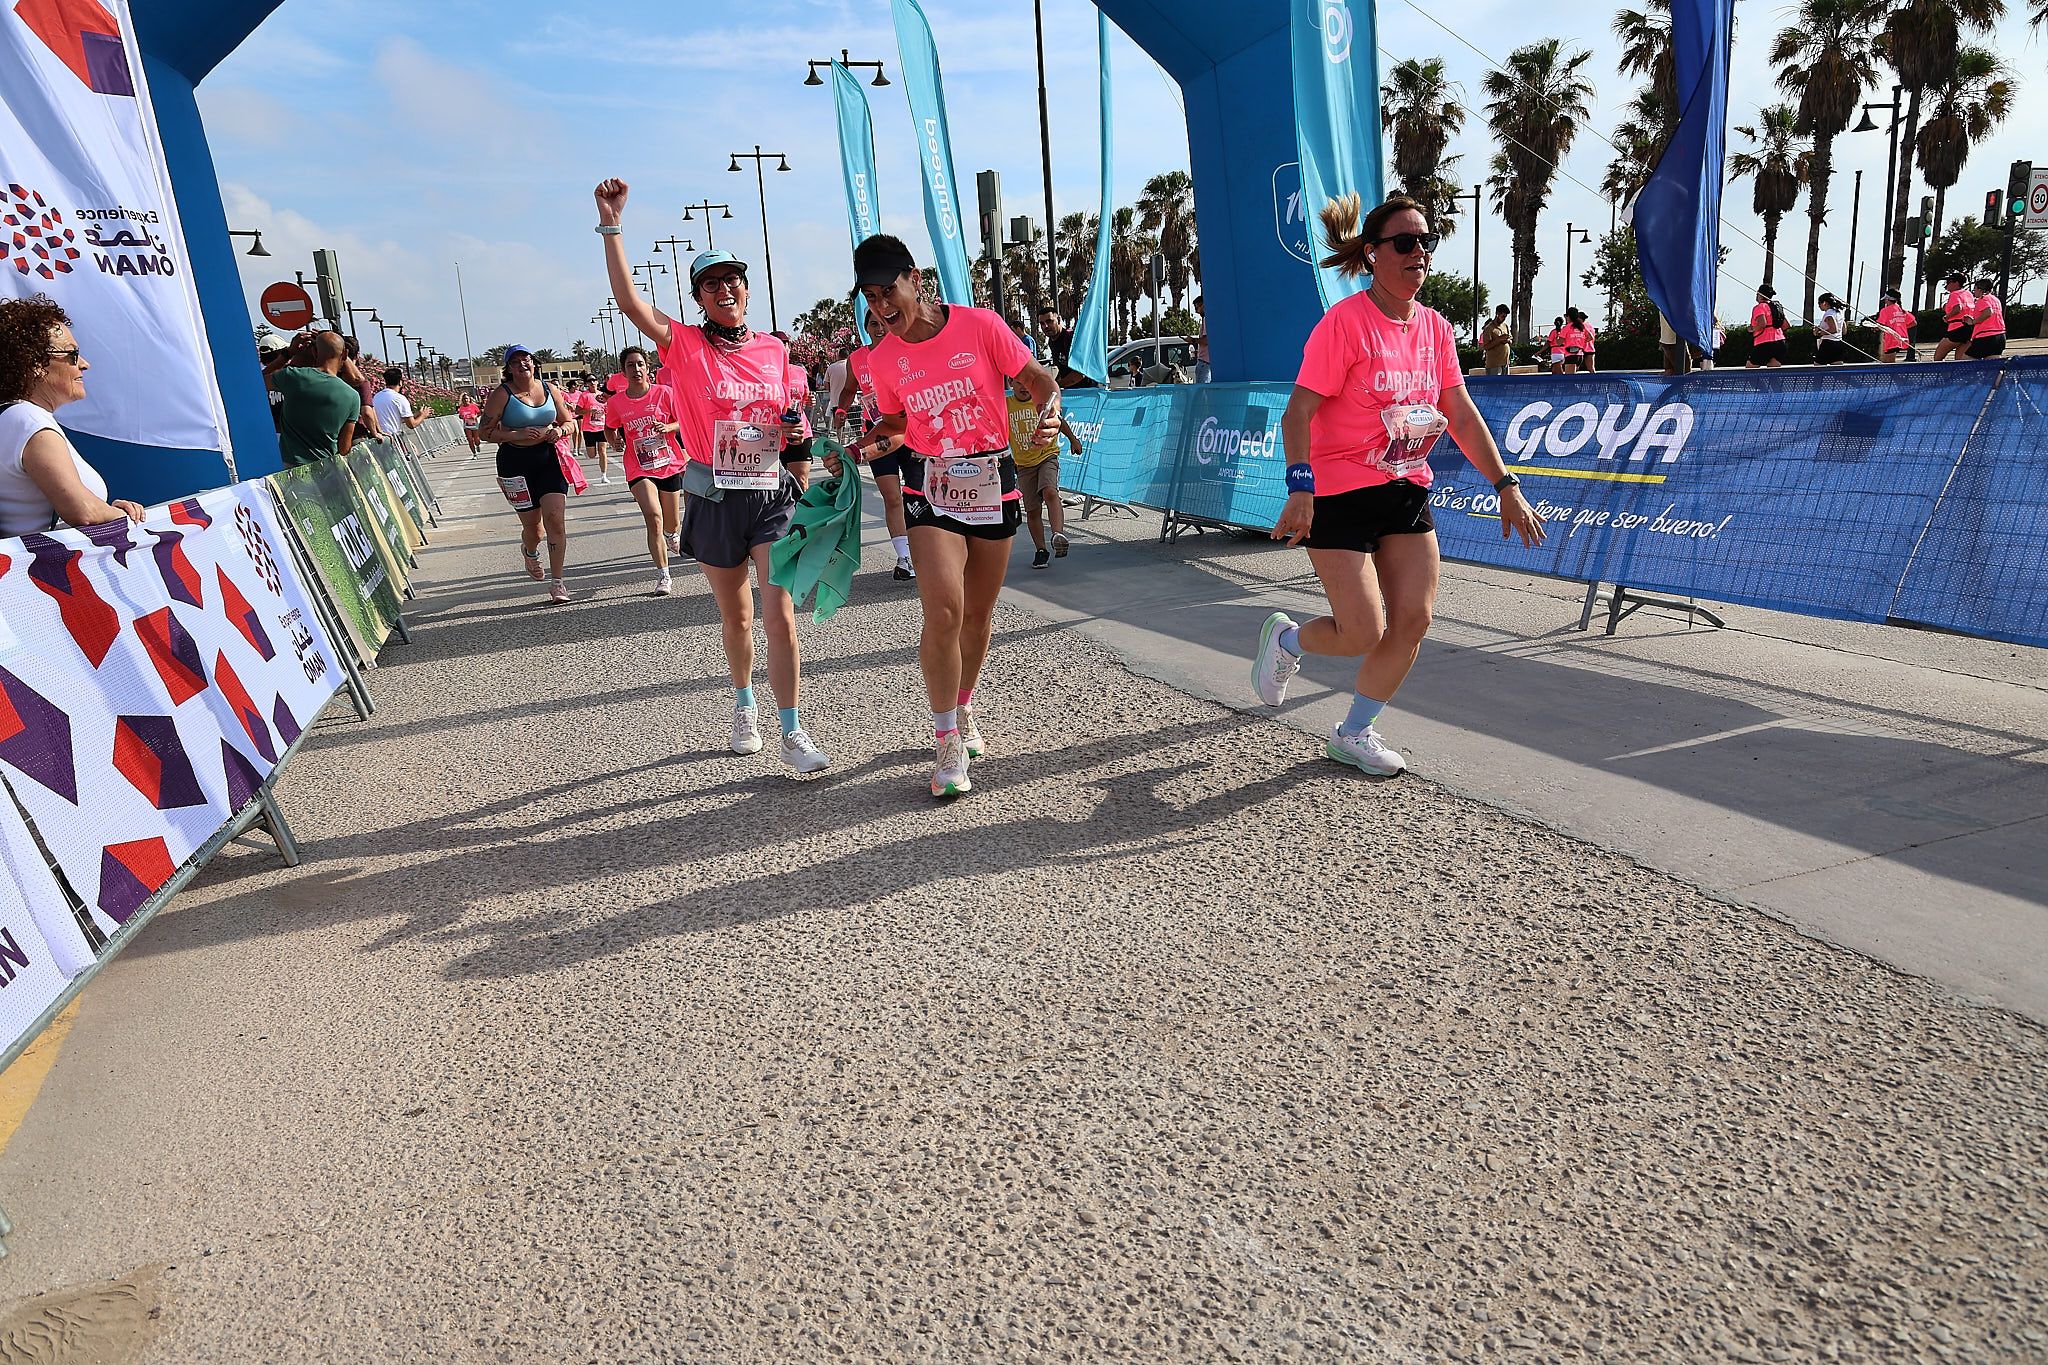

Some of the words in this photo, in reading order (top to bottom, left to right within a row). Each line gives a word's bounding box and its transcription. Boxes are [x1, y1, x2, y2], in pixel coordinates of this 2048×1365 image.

[2034, 193, 2046, 204] 30
[1371, 349, 1399, 359] OYSHO
[900, 369, 926, 386] OYSHO
[1374, 370, 1434, 392] CARRERA
[716, 381, 782, 401] CARRERA
[906, 376, 977, 413] CARRERA
[1009, 408, 1041, 421] RUMBL
[1024, 419, 1040, 432] TH
[1057, 412, 1104, 447] Cmpeed
[1505, 401, 1694, 463] GOYA
[1197, 416, 1278, 464] Compeed
[738, 452, 761, 465] 016
[1218, 468, 1245, 480] AMPOLLAS
[949, 488, 978, 500] 016
[1451, 496, 1472, 510] es
[1534, 499, 1573, 522] tiene
[1569, 509, 1609, 538] que
[1610, 511, 1648, 529] ser
[1649, 504, 1733, 538] bueno!
[303, 650, 327, 685] OMAN
